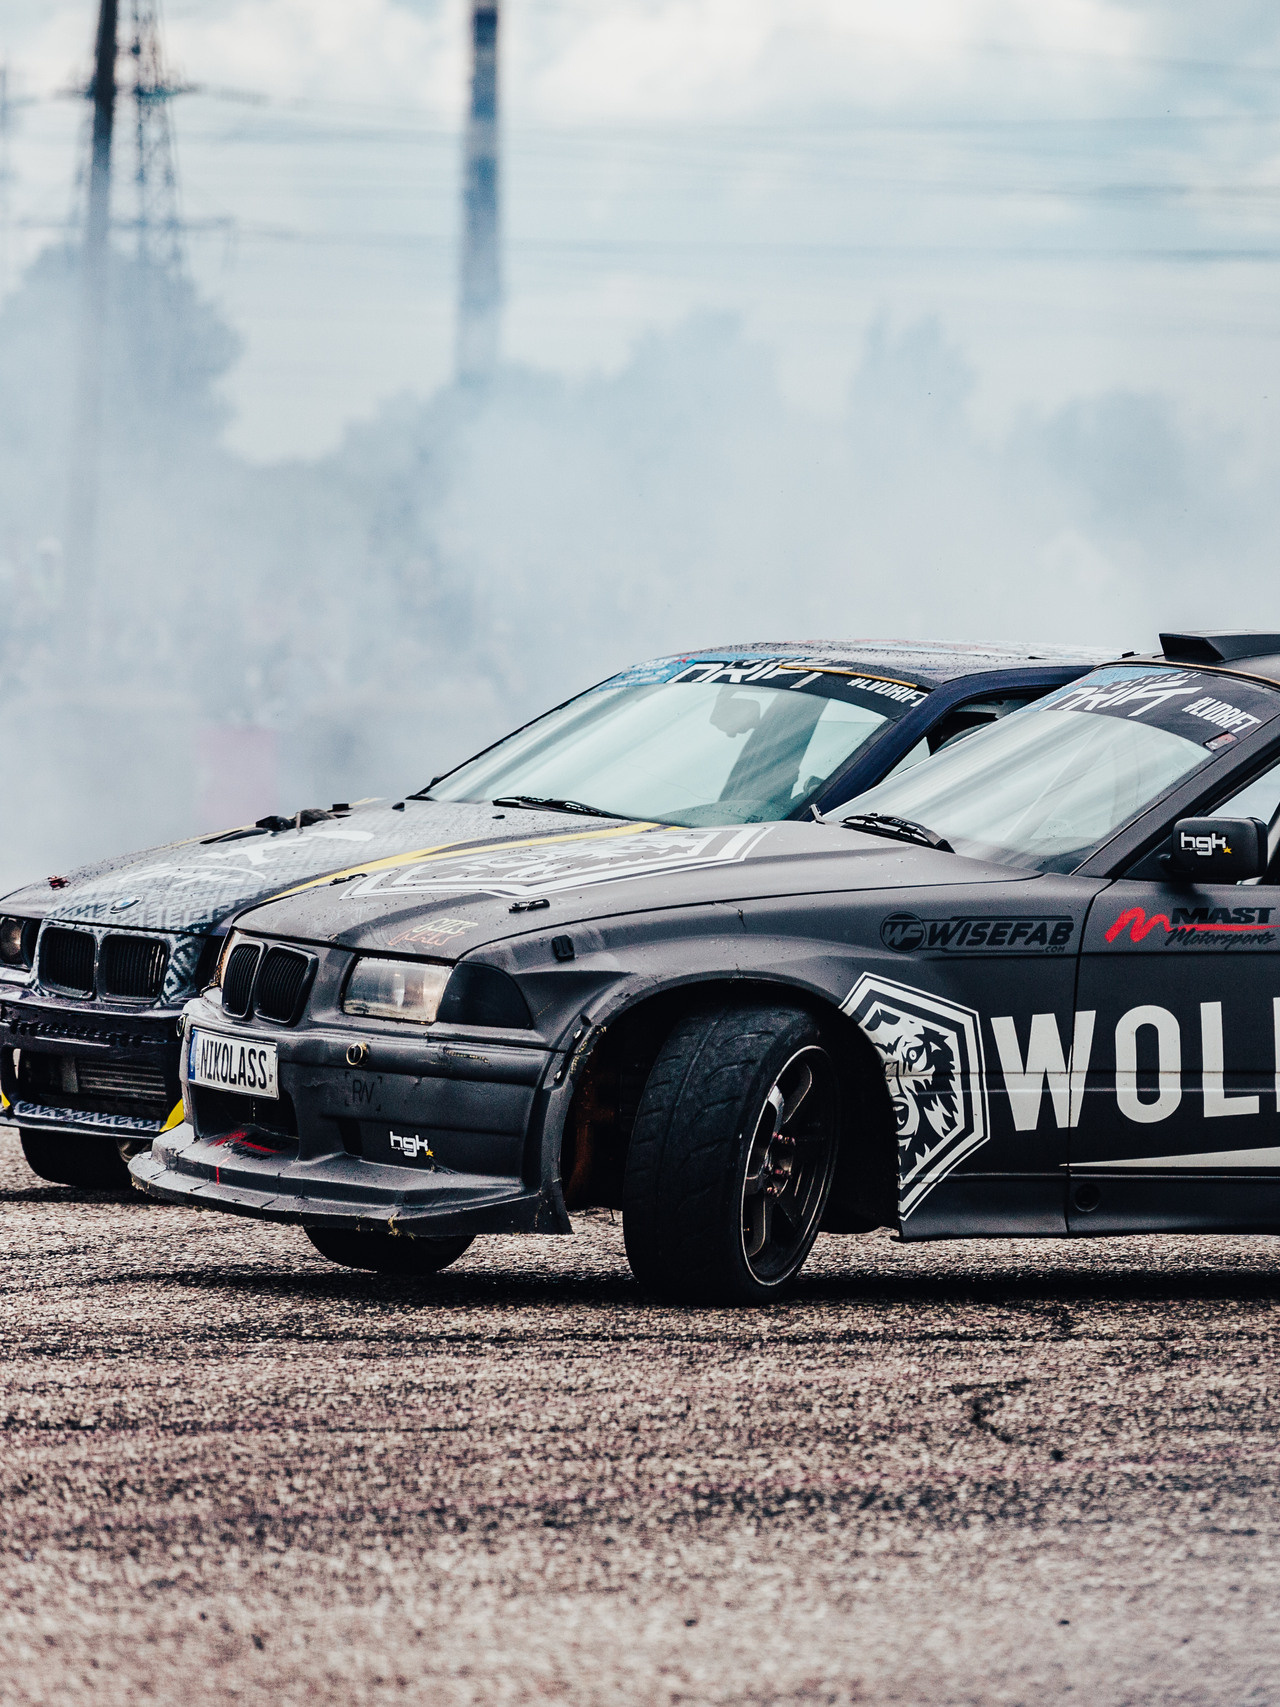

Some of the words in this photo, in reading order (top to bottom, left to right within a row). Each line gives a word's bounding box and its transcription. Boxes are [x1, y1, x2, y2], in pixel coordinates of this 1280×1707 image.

[665, 662, 852, 689] DRIFT
[1037, 680, 1203, 717] DRIFT
[1181, 696, 1262, 733] #LVDRIFT
[1181, 832, 1227, 856] hgk
[1171, 907, 1276, 924] MAST
[928, 922, 1075, 946] WISEFAB
[1165, 927, 1276, 950] Motorsports
[200, 1038, 267, 1090] NIKOLASS
[389, 1130, 429, 1158] hgk
